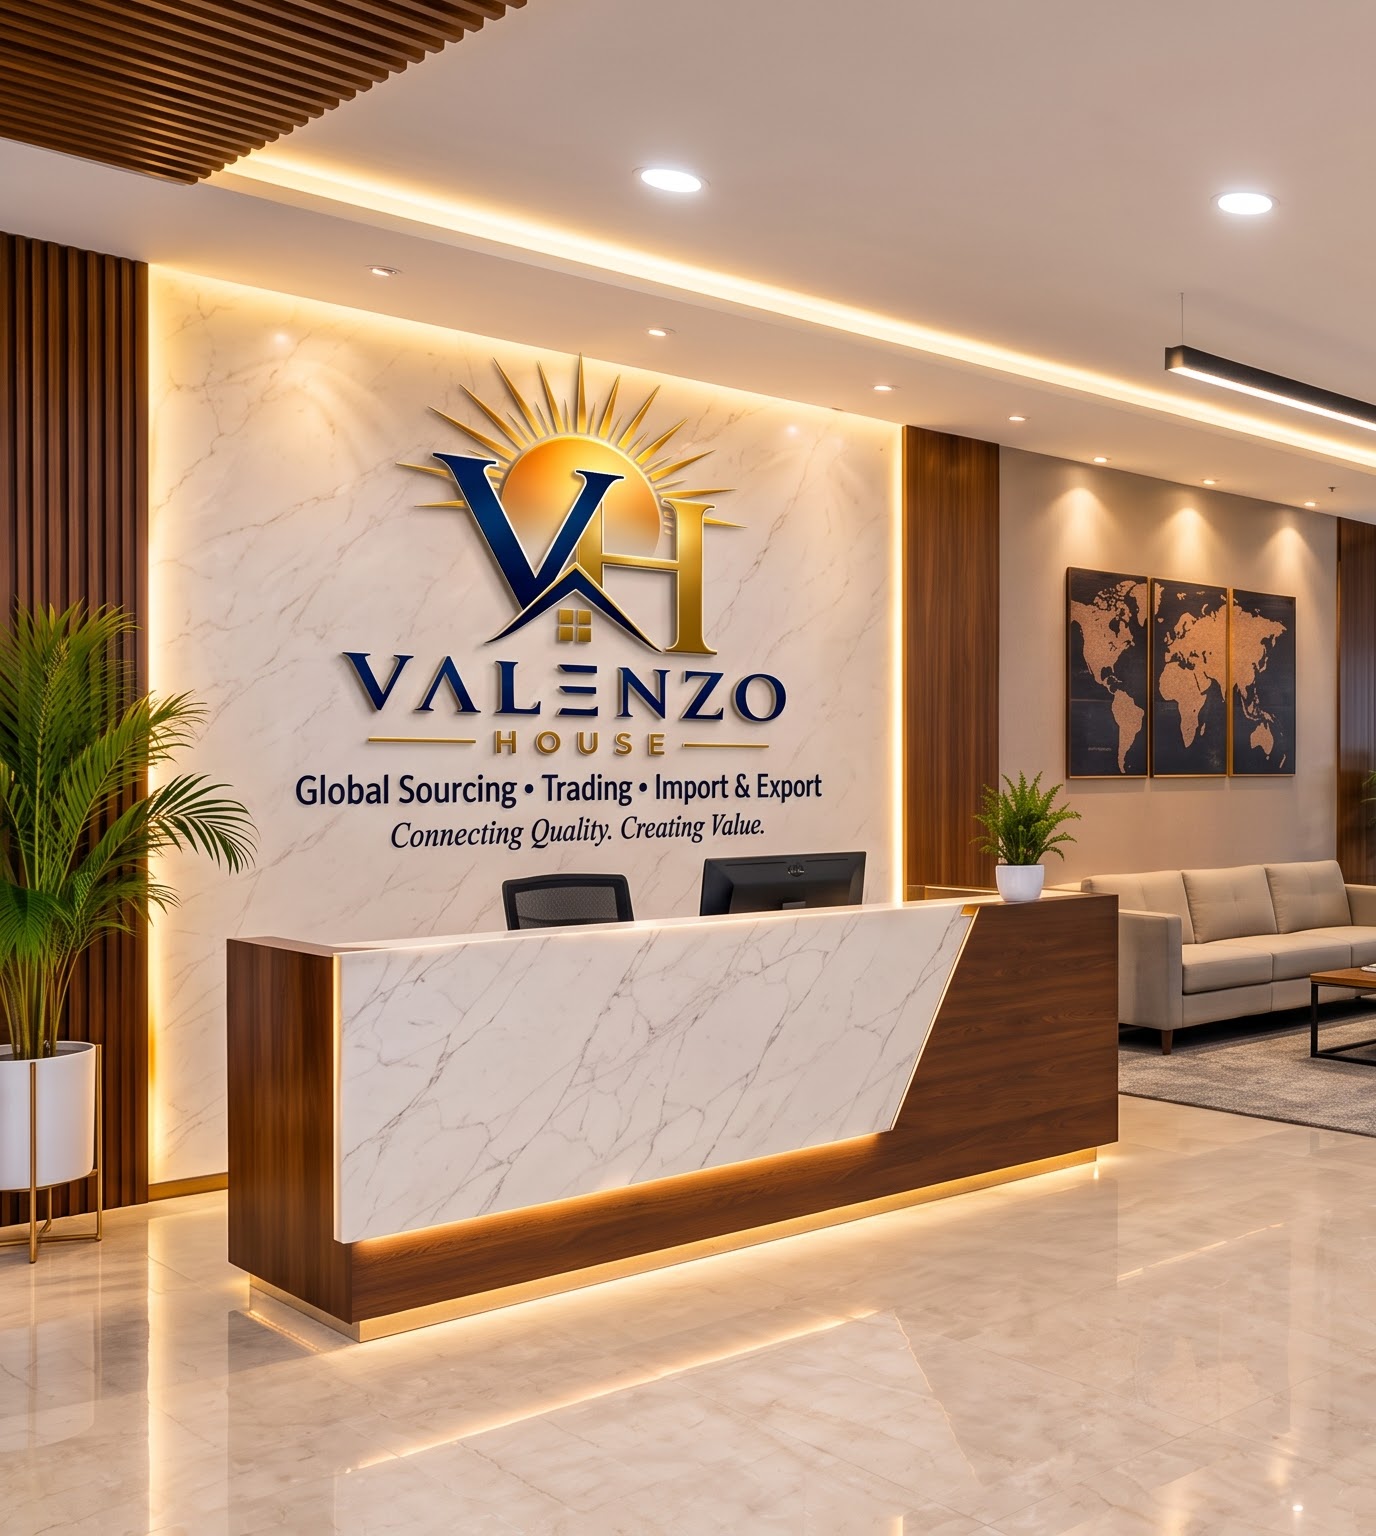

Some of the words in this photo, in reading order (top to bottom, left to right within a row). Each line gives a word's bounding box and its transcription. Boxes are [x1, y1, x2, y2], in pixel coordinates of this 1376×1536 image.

[341, 651, 787, 724] VALENZO
[495, 730, 665, 756] HOUSE
[295, 773, 389, 806] Global
[398, 773, 518, 809] Sourcing
[541, 773, 633, 807] Trading
[655, 773, 729, 806] Import
[734, 773, 751, 799] &
[757, 773, 823, 804] Export
[390, 820, 525, 851] Connecting
[531, 816, 613, 849] Quality.
[620, 815, 706, 844] Creating
[711, 812, 766, 838] Value.
